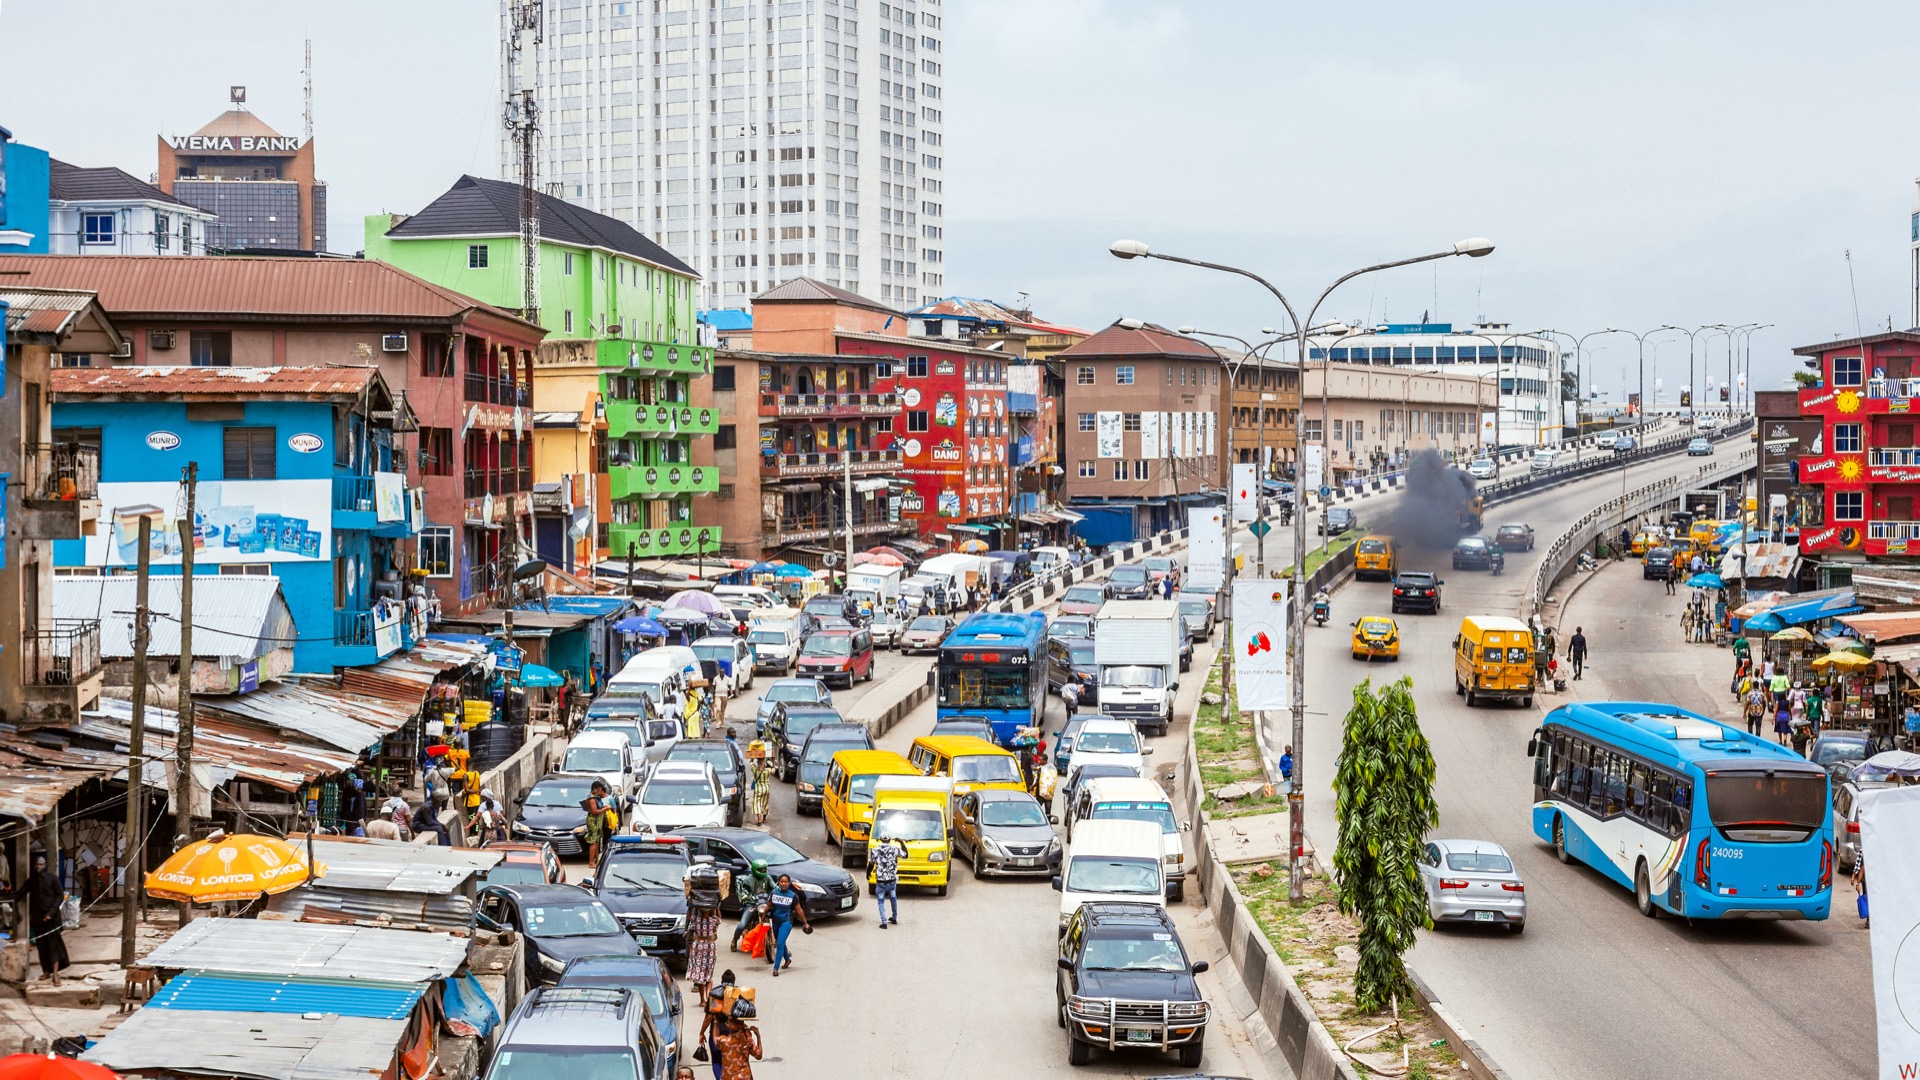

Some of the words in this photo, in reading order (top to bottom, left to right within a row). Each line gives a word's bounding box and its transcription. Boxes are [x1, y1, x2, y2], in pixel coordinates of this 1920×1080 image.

[172, 136, 234, 150] WEMA
[240, 136, 298, 150] BANK
[1803, 394, 1834, 407] Breakfast
[934, 450, 959, 460] DANO
[1807, 460, 1836, 473] Lunch
[1871, 468, 1890, 477] Meal
[901, 500, 921, 510] ANO
[1806, 528, 1835, 547] Dinner
[1712, 847, 1743, 859] 240095
[260, 864, 304, 879] LONTOR
[158, 872, 195, 885] LONTOR
[201, 873, 254, 885] LONTOR
[1899, 1062, 1920, 1080] W
